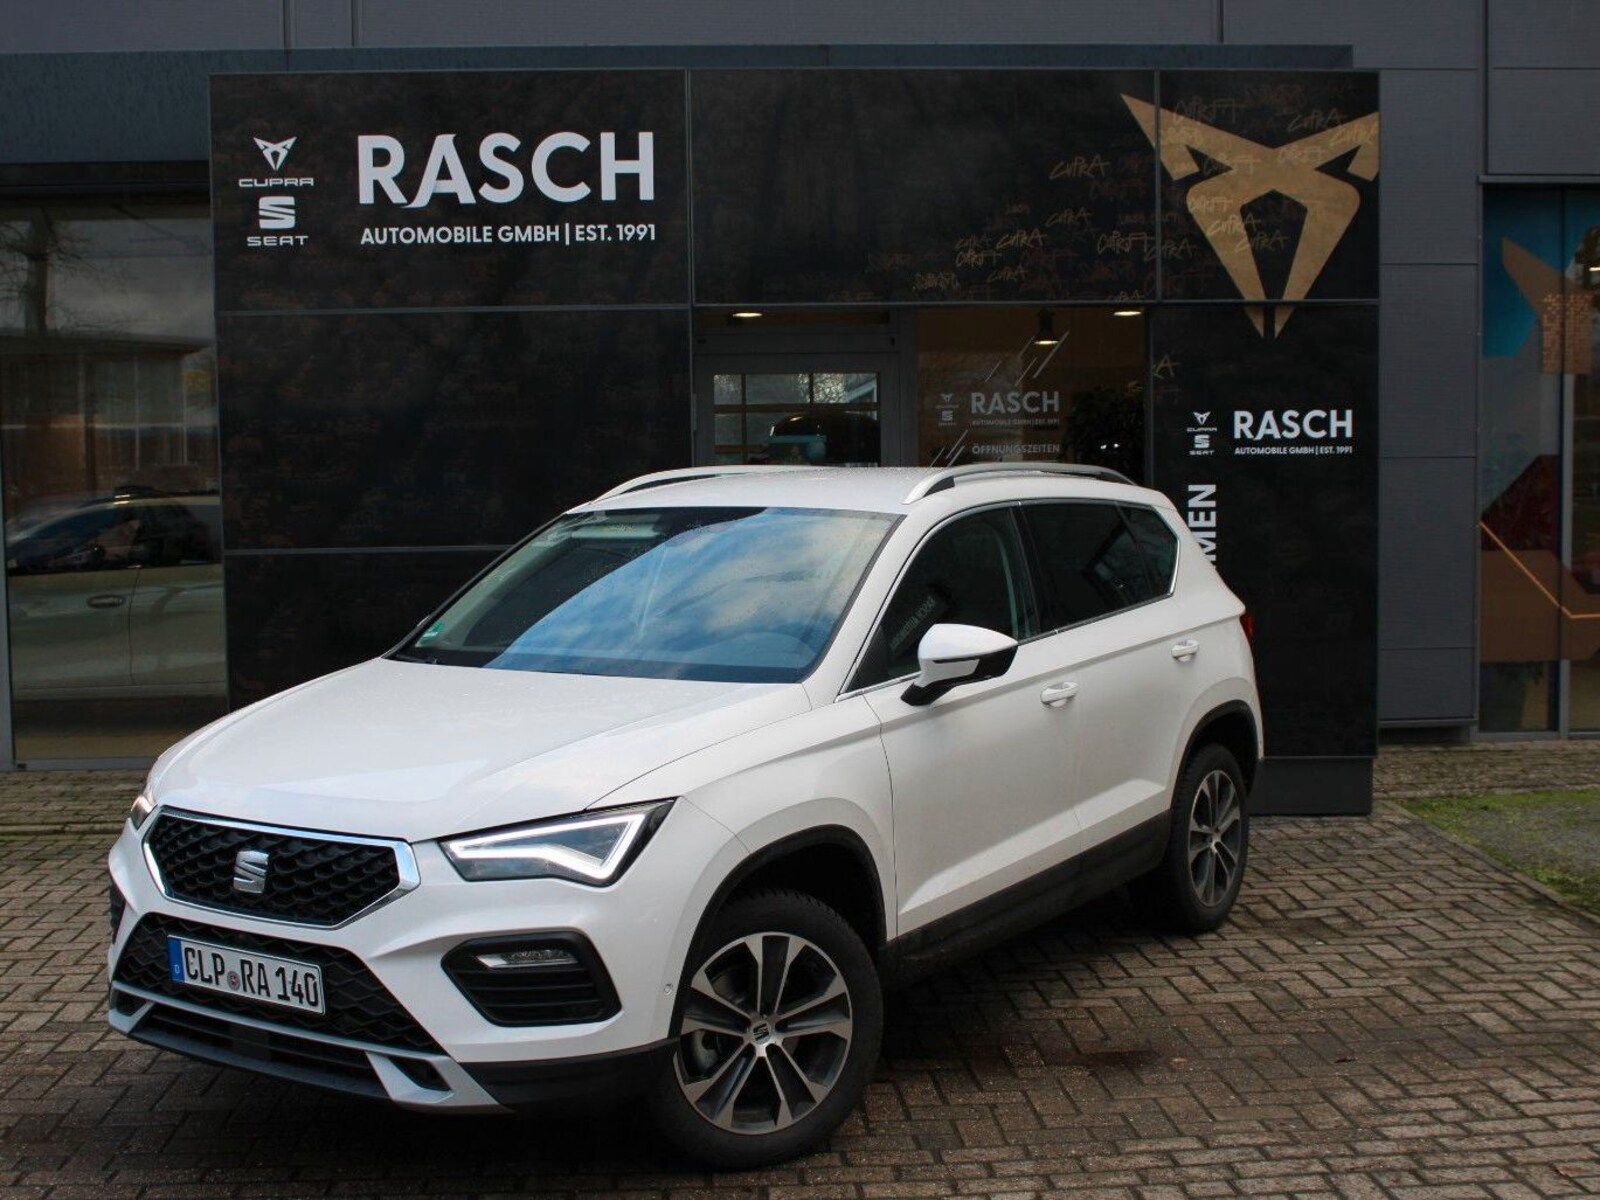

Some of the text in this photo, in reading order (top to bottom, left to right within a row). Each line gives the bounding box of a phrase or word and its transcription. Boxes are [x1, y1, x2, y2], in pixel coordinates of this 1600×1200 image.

[238, 177, 314, 188] CUPRA
[357, 131, 655, 209] RASCH
[246, 235, 309, 247] SEAT
[360, 225, 493, 246] AUTOMOBILE
[497, 224, 560, 244] GMBH
[575, 224, 613, 243] EST.
[615, 222, 656, 242] 1991
[970, 390, 1060, 416] RASCH
[1233, 409, 1353, 441] RASCH
[971, 442, 1061, 455] ÖFFNUNGSZEITEN
[1234, 446, 1287, 456] AUTOMOBILE
[1288, 446, 1314, 455] GMBH
[1336, 446, 1353, 455] 1991
[1187, 484, 1217, 568] MEN
[184, 947, 319, 1007] CLP RA 140
